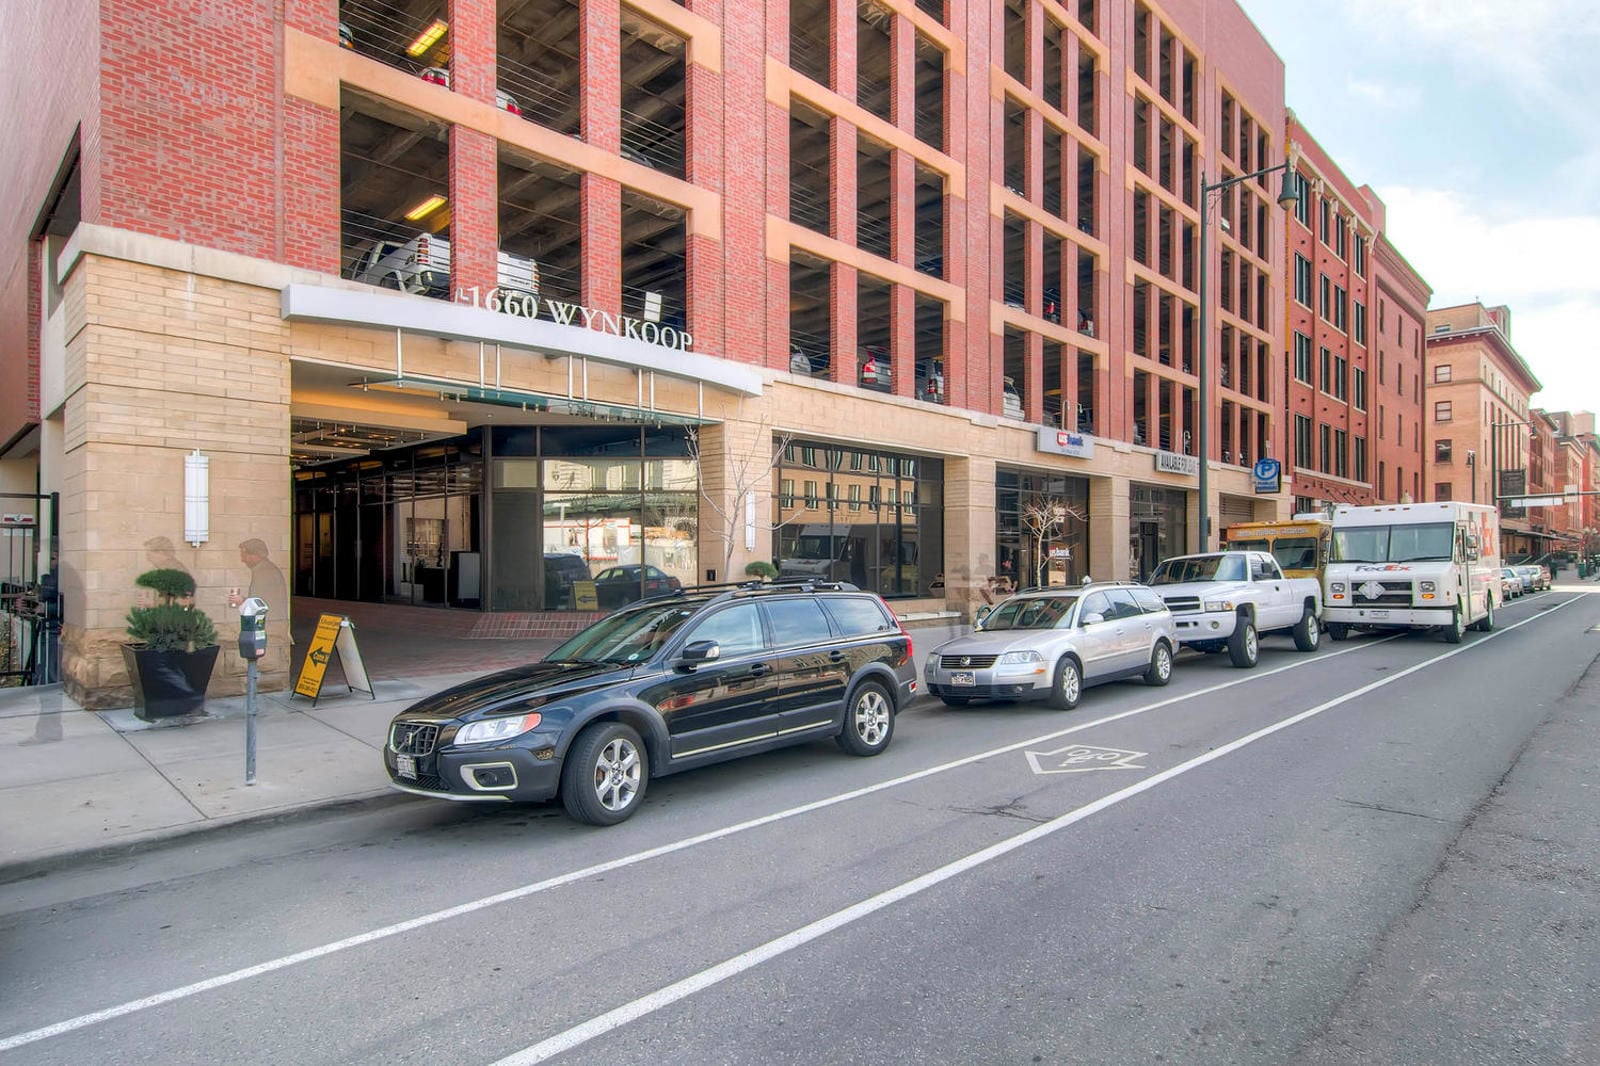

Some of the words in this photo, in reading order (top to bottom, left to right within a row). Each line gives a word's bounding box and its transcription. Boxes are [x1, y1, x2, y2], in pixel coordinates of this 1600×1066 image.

[467, 286, 538, 320] 1660
[545, 299, 693, 352] WYNKOOP
[1355, 564, 1412, 572] FedEx
